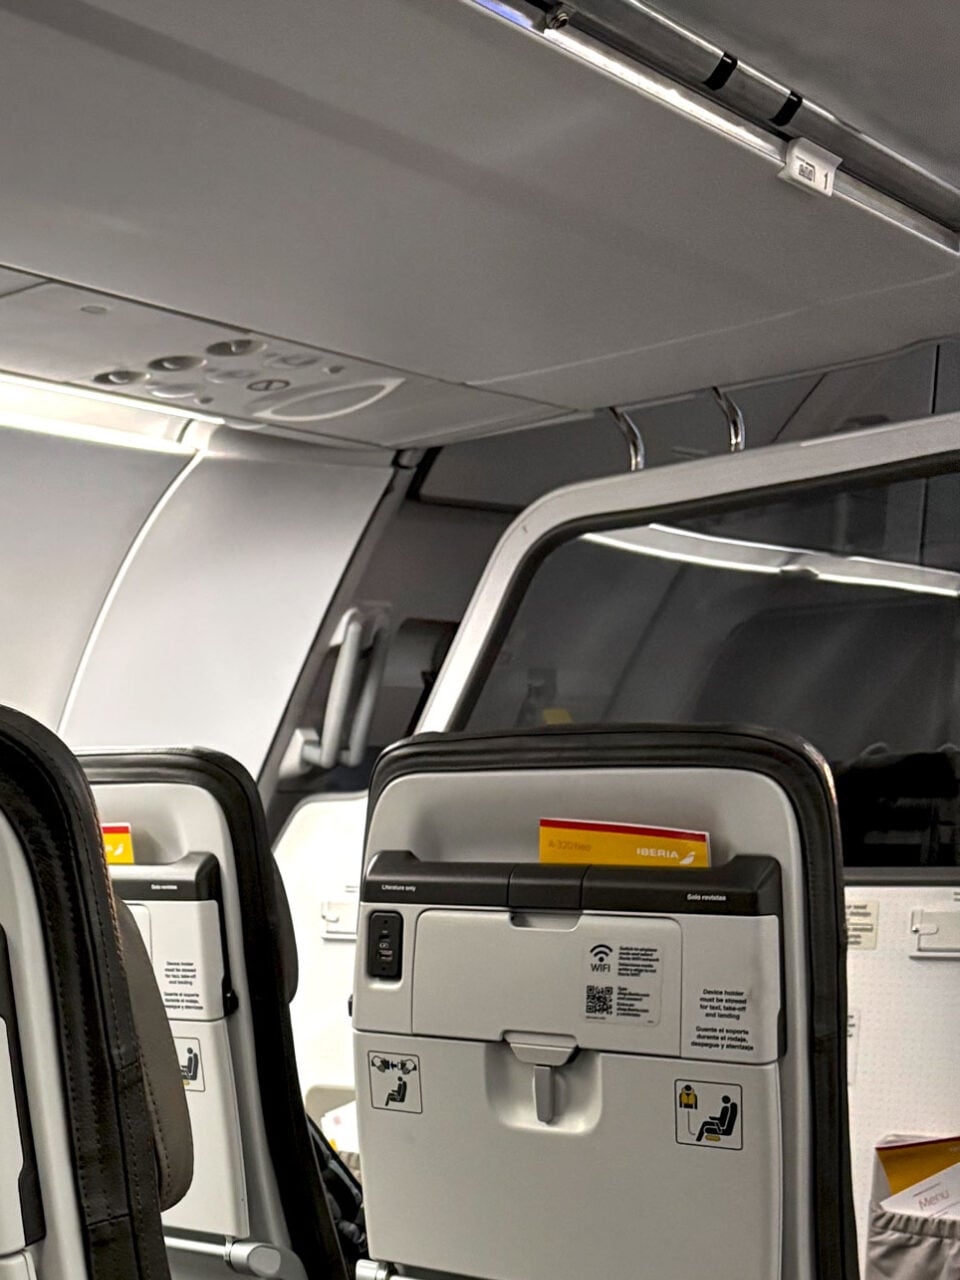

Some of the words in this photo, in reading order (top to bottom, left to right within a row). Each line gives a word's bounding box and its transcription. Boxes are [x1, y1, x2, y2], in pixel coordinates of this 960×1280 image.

[824, 172, 828, 190] 1
[636, 847, 679, 859] IBERIA
[590, 963, 611, 973] WIFI
[919, 1190, 950, 1210] Menu
